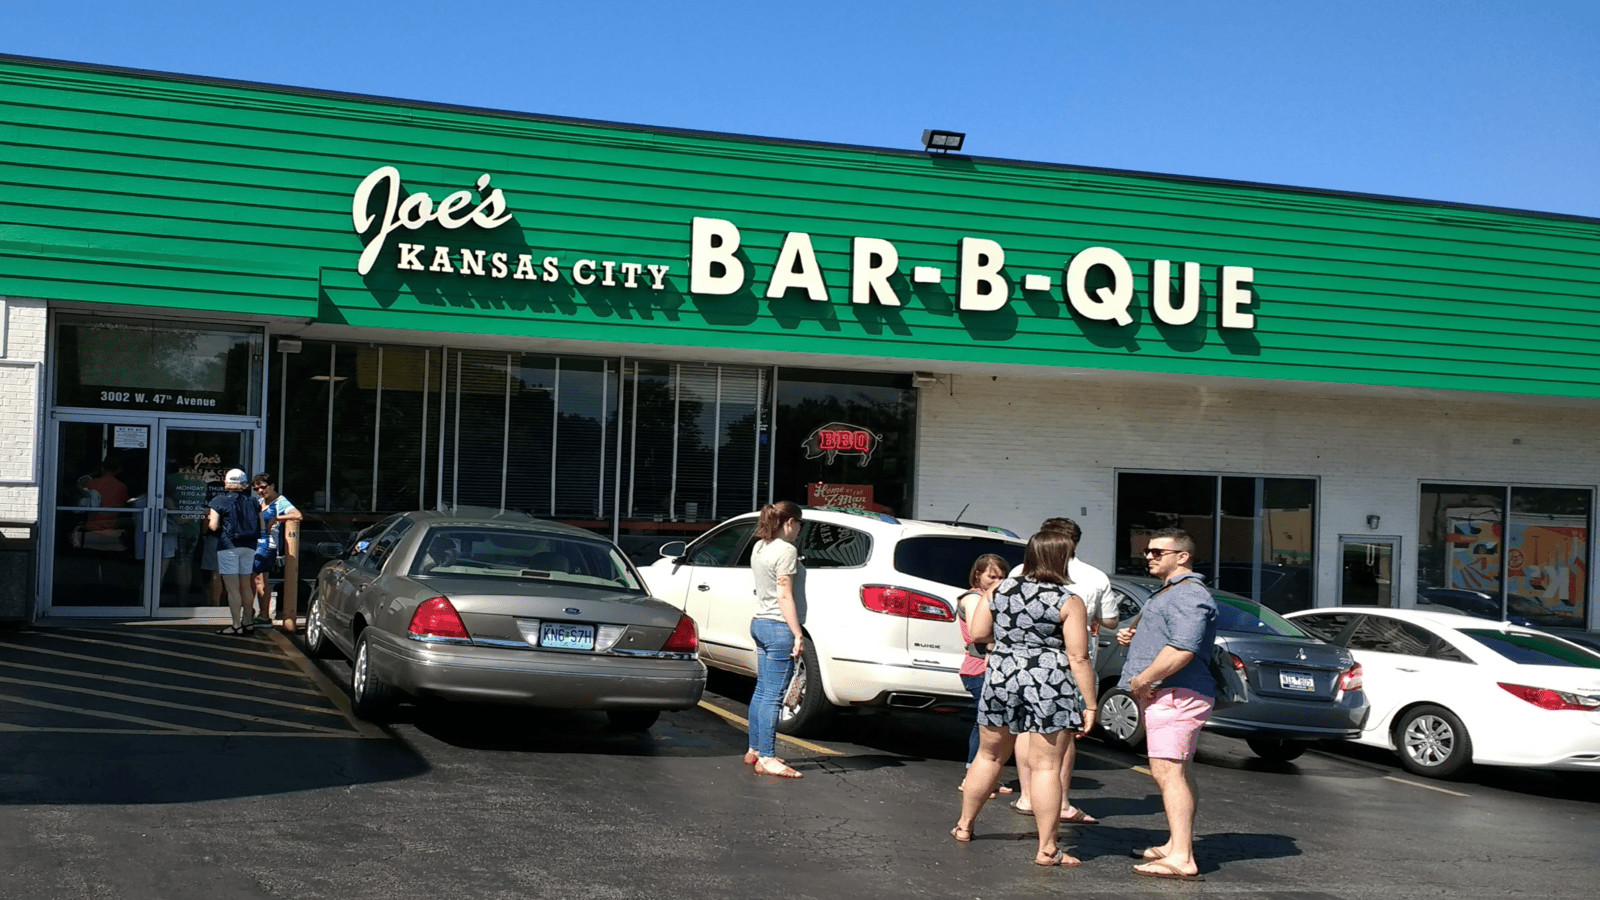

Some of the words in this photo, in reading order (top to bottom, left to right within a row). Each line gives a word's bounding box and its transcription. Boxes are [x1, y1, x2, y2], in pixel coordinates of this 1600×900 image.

[353, 166, 512, 275] Joe's
[398, 243, 559, 284] KANSAS
[572, 259, 670, 290] CITY
[690, 216, 1254, 329] BAR-B-QUE
[100, 391, 130, 402] 3002
[135, 393, 148, 403] W.
[153, 394, 173, 404] 47th
[176, 395, 216, 407] Avenue
[819, 430, 869, 453] BBQ
[193, 452, 222, 470] Joe's
[814, 484, 844, 498] Home
[914, 642, 941, 650] BUICK
